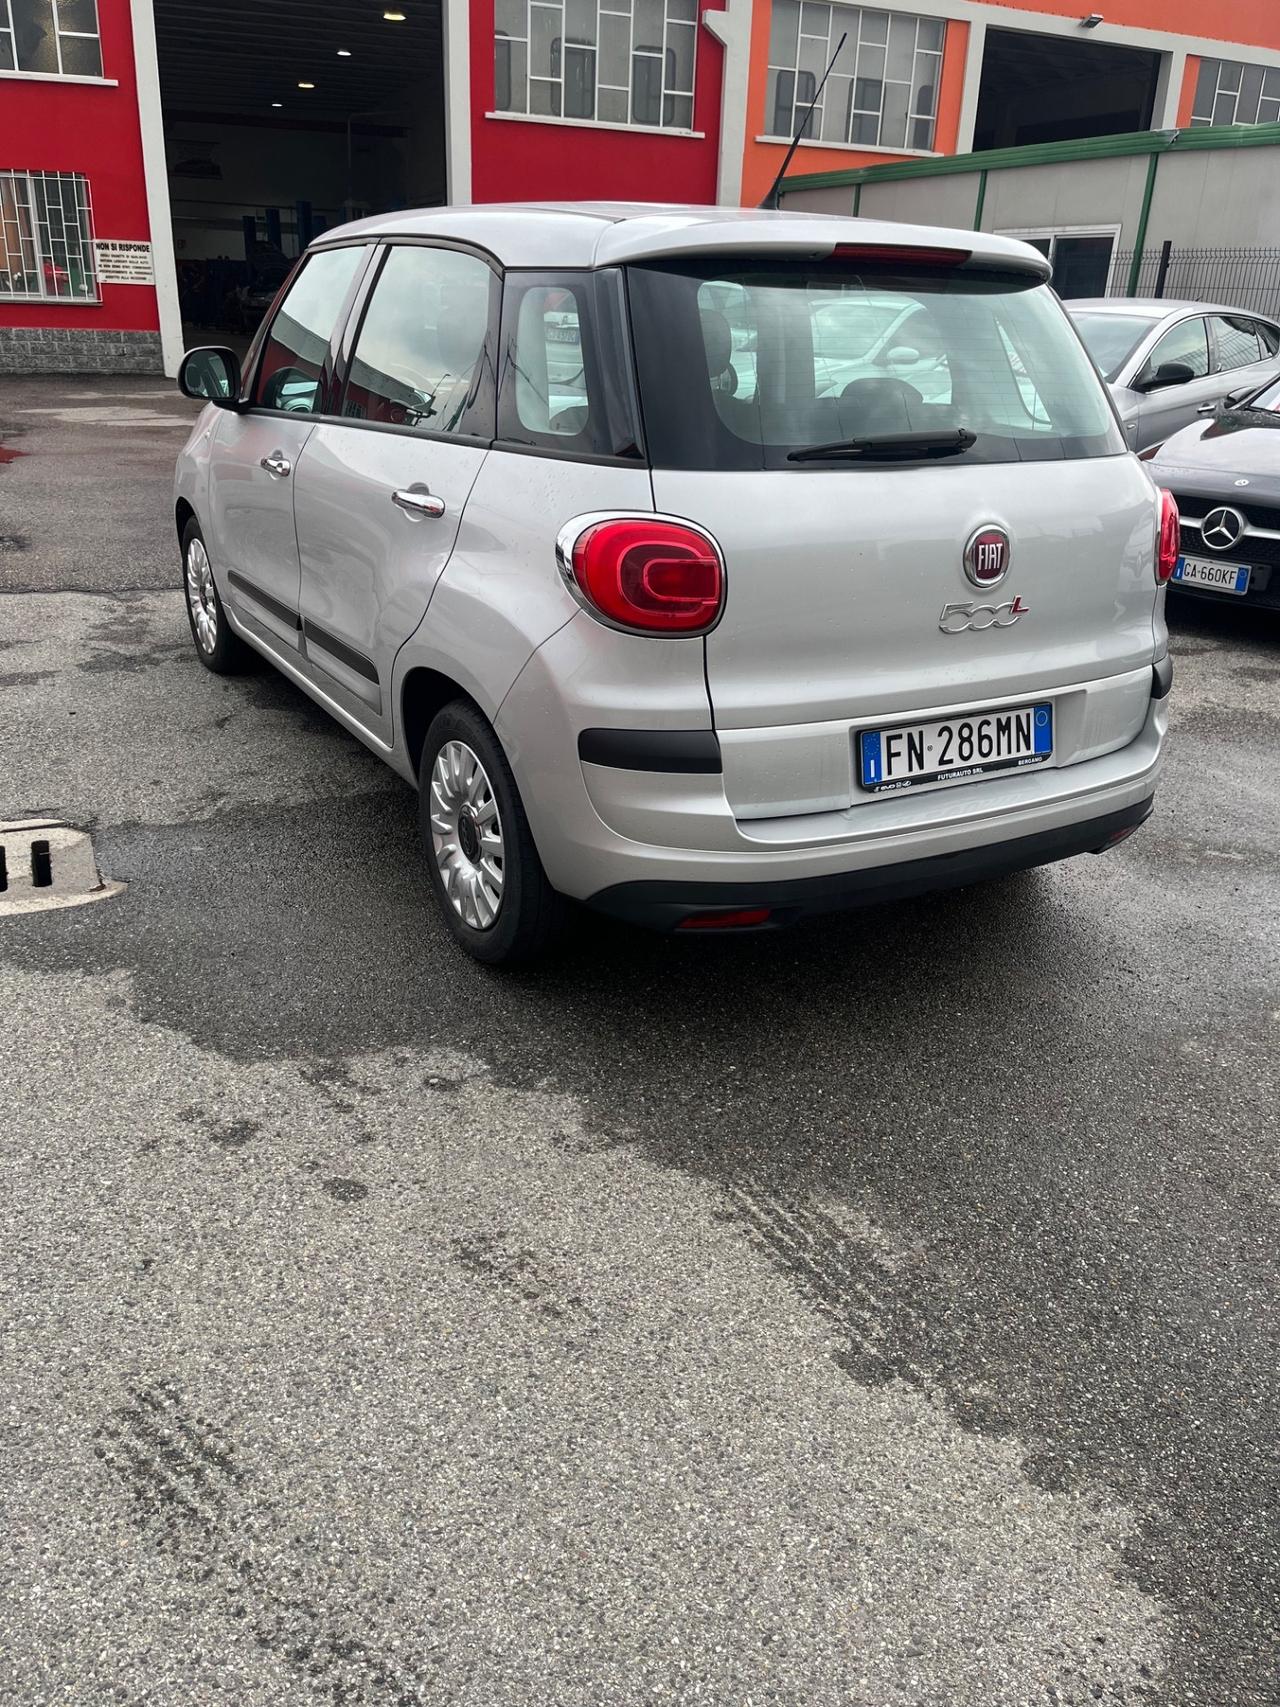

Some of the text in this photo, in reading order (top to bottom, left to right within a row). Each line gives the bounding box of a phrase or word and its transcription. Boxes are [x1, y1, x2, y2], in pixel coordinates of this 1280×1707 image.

[111, 243, 117, 251] SI
[119, 244, 150, 252] RISPONDE
[977, 543, 1003, 571] FIAT
[938, 594, 1030, 635] 500L
[1018, 756, 1043, 766] BERGAMO
[937, 767, 984, 781] FUTURAUTO SRL
